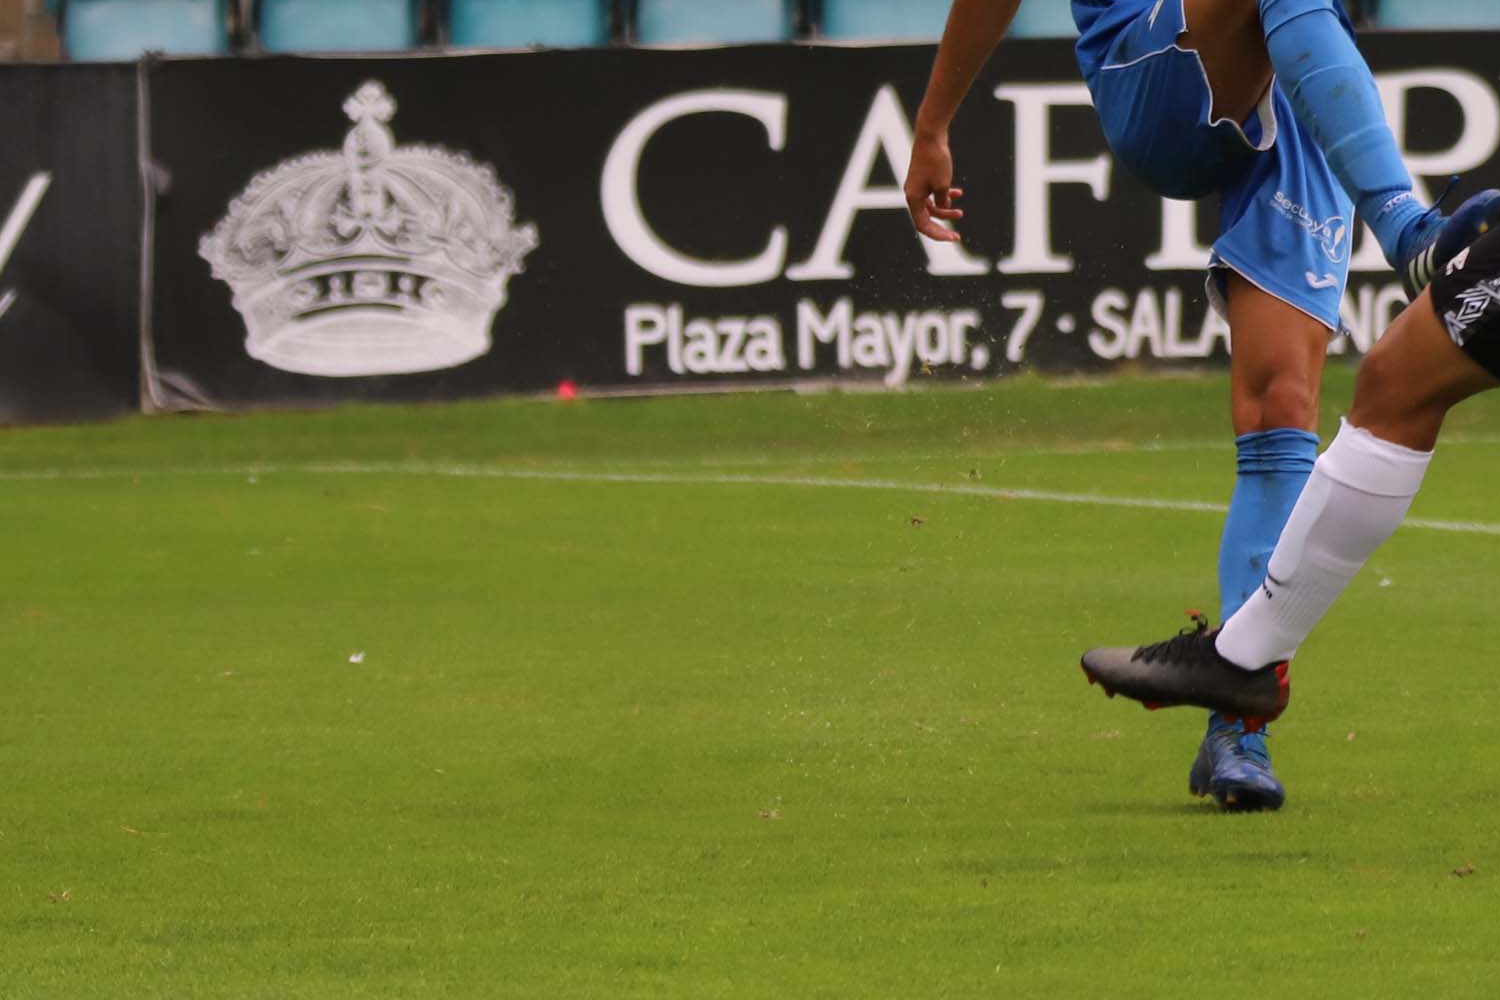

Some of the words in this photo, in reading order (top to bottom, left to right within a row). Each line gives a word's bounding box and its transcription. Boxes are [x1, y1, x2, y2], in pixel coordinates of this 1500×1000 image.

[624, 302, 784, 377] Plaza
[797, 297, 989, 387] Mayor,
[1001, 290, 1044, 363] 7
